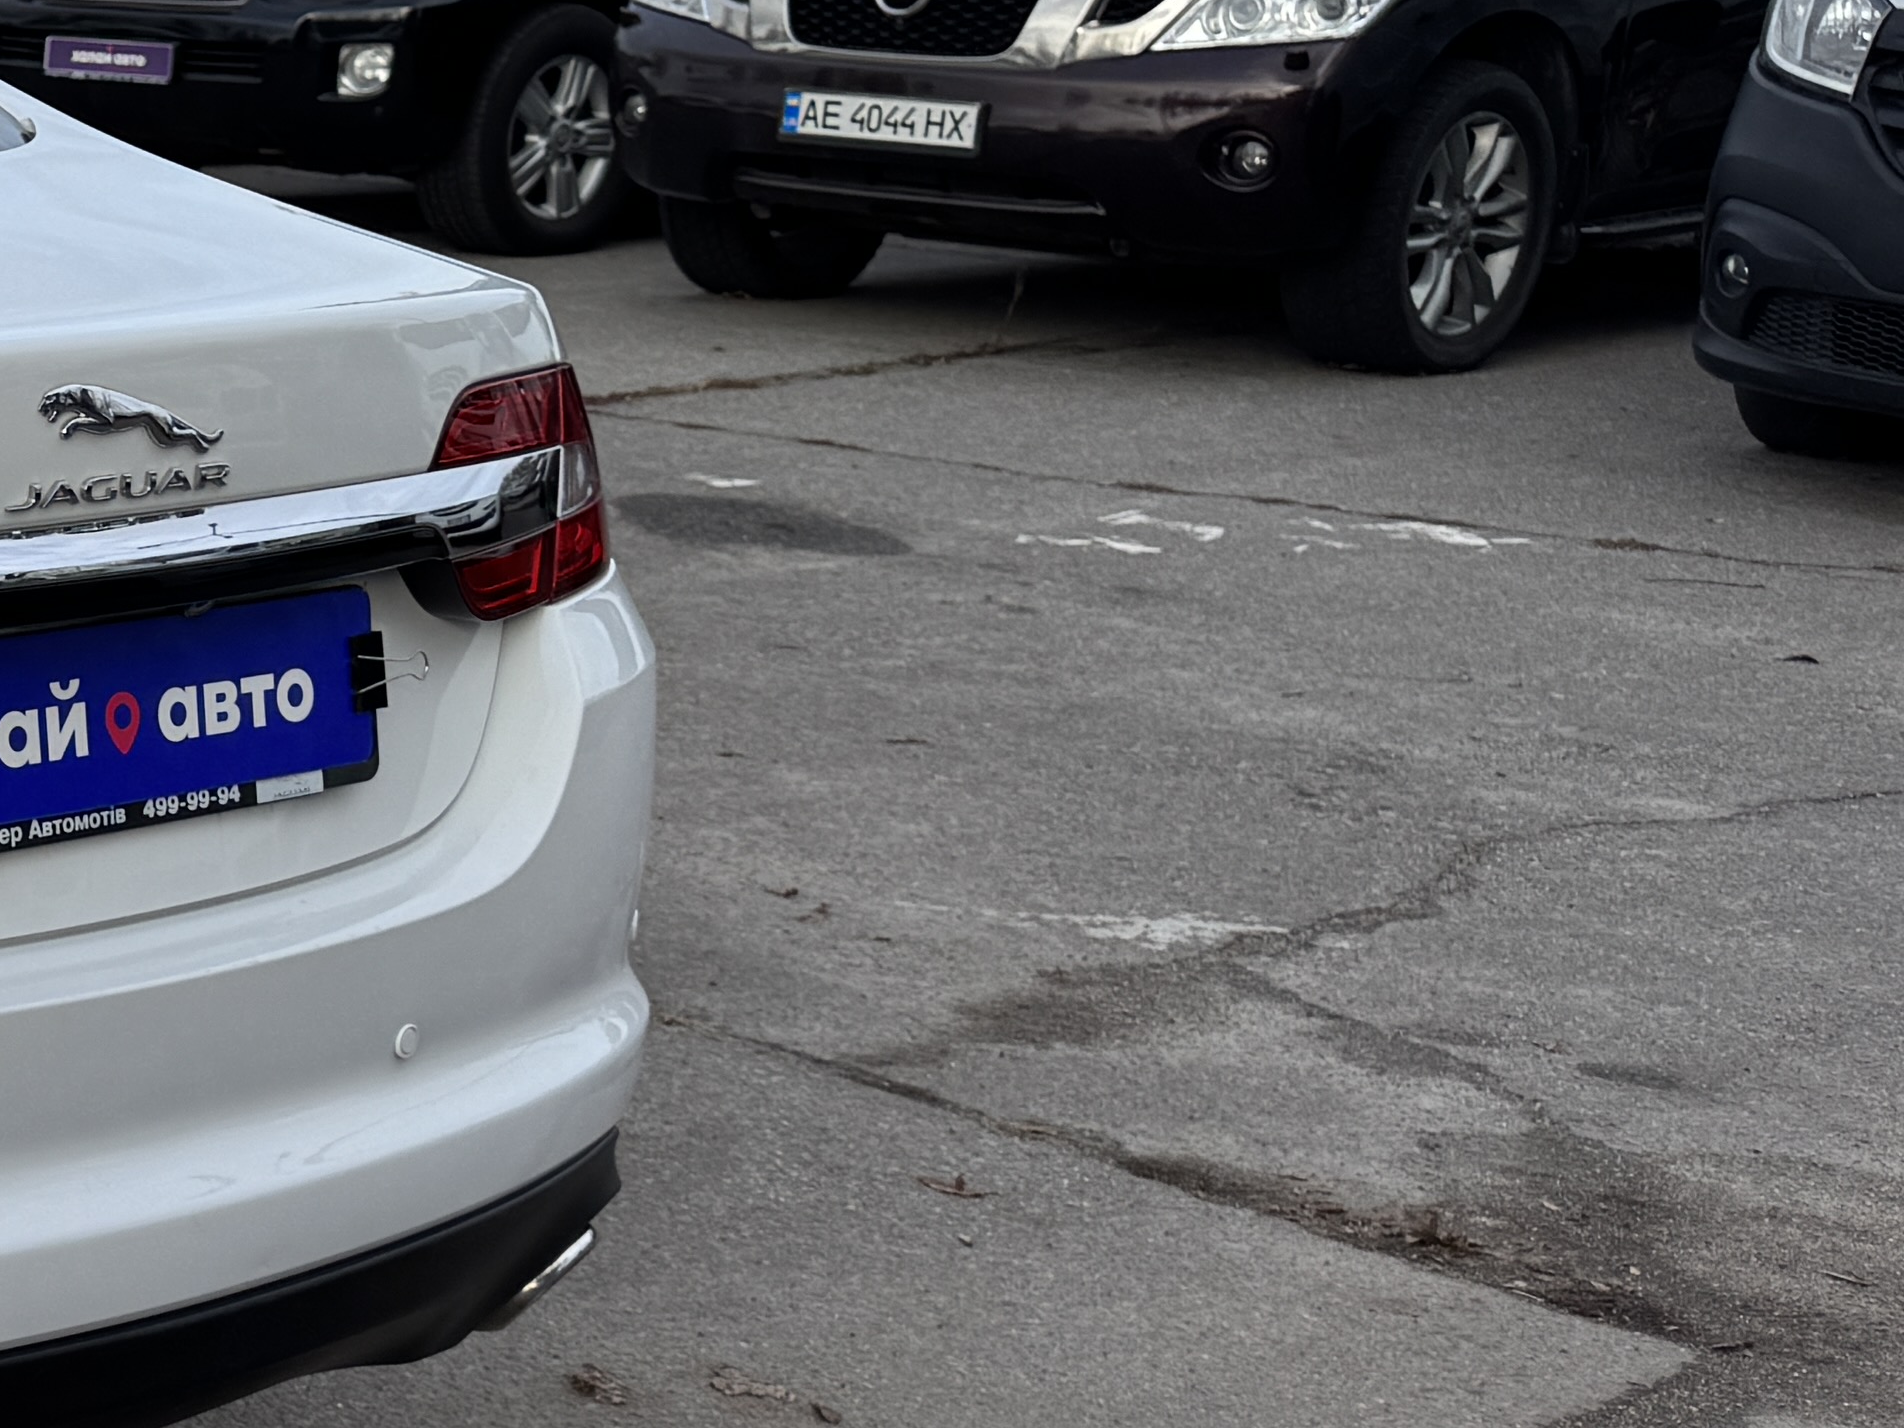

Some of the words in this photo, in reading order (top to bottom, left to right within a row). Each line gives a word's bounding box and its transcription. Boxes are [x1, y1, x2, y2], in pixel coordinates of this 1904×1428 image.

[801, 99, 842, 131] AE
[850, 102, 916, 137] 4044
[924, 108, 969, 141] HX
[5, 461, 231, 512] JAGUAR
[157, 668, 315, 743] авто
[28, 804, 127, 840] Автомотів
[142, 785, 242, 819] 499-99-94
